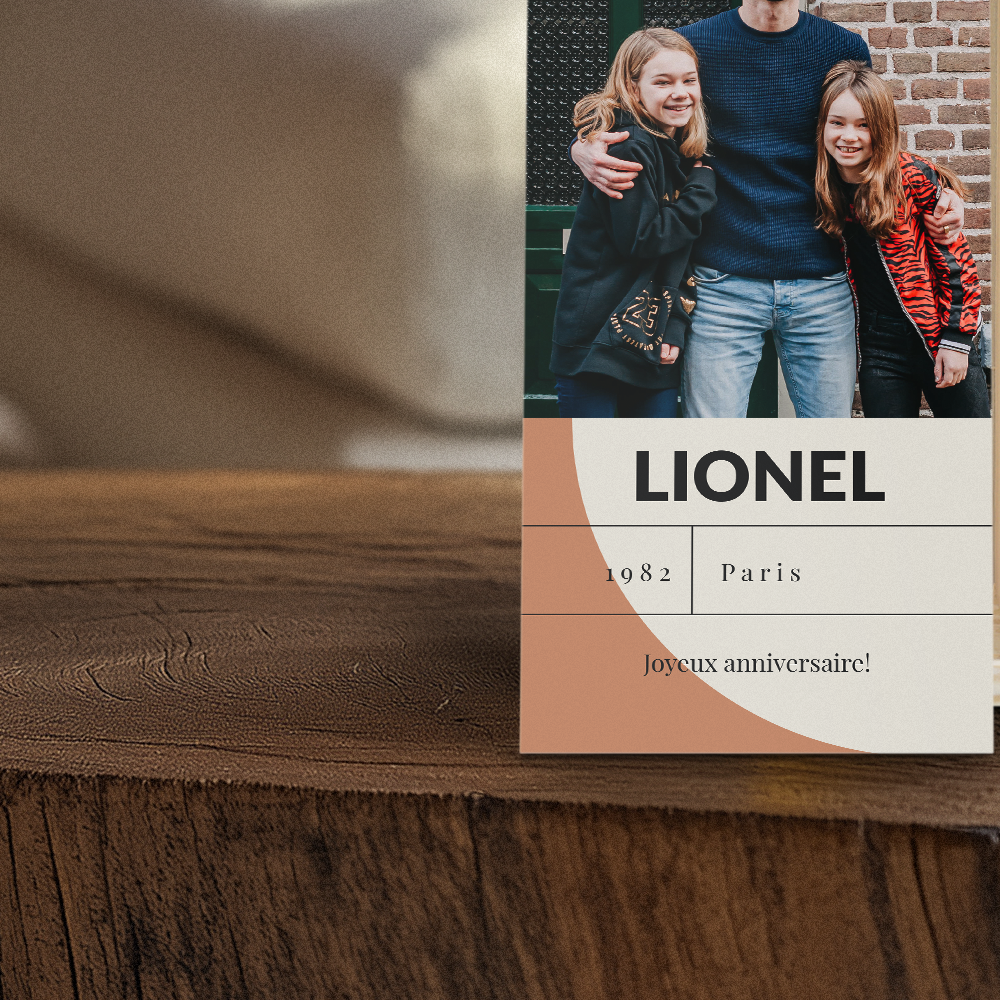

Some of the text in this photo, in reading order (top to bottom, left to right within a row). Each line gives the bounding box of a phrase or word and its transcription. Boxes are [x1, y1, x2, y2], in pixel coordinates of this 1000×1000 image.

[635, 450, 886, 502] LIONEL
[605, 562, 672, 584] 1982
[721, 562, 802, 583] Paris
[643, 652, 871, 677] Joyeux anniversaire!
